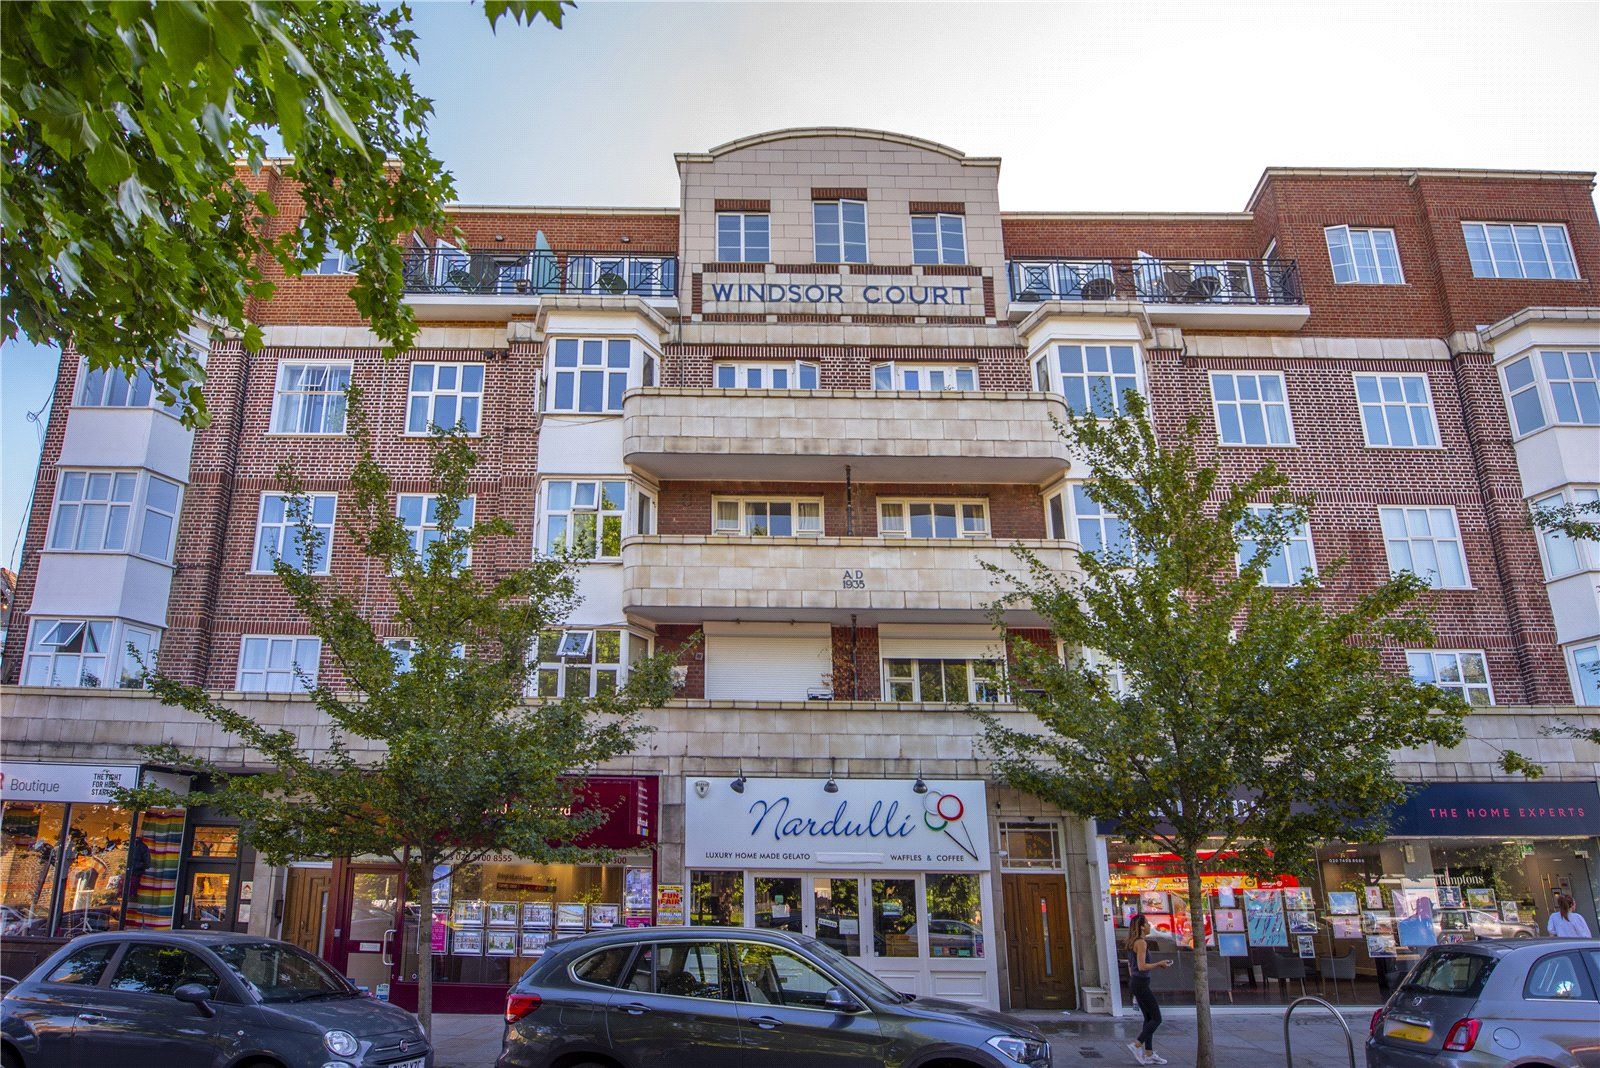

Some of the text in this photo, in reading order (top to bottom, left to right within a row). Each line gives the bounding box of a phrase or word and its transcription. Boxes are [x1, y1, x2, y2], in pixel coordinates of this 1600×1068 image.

[711, 284, 972, 305] WINDSOR COURT
[842, 579, 866, 589] 1935
[93, 773, 104, 781] THE
[10, 778, 61, 794] Boutique
[91, 780, 104, 788] FOR
[1429, 808, 1585, 818] THE HOME EXPERTS
[749, 796, 916, 841] Nardulli
[493, 854, 513, 862] 8555
[705, 852, 811, 861] LUXURY HOME MADE GELATO
[890, 854, 965, 862] WAFFLES & COFFEE
